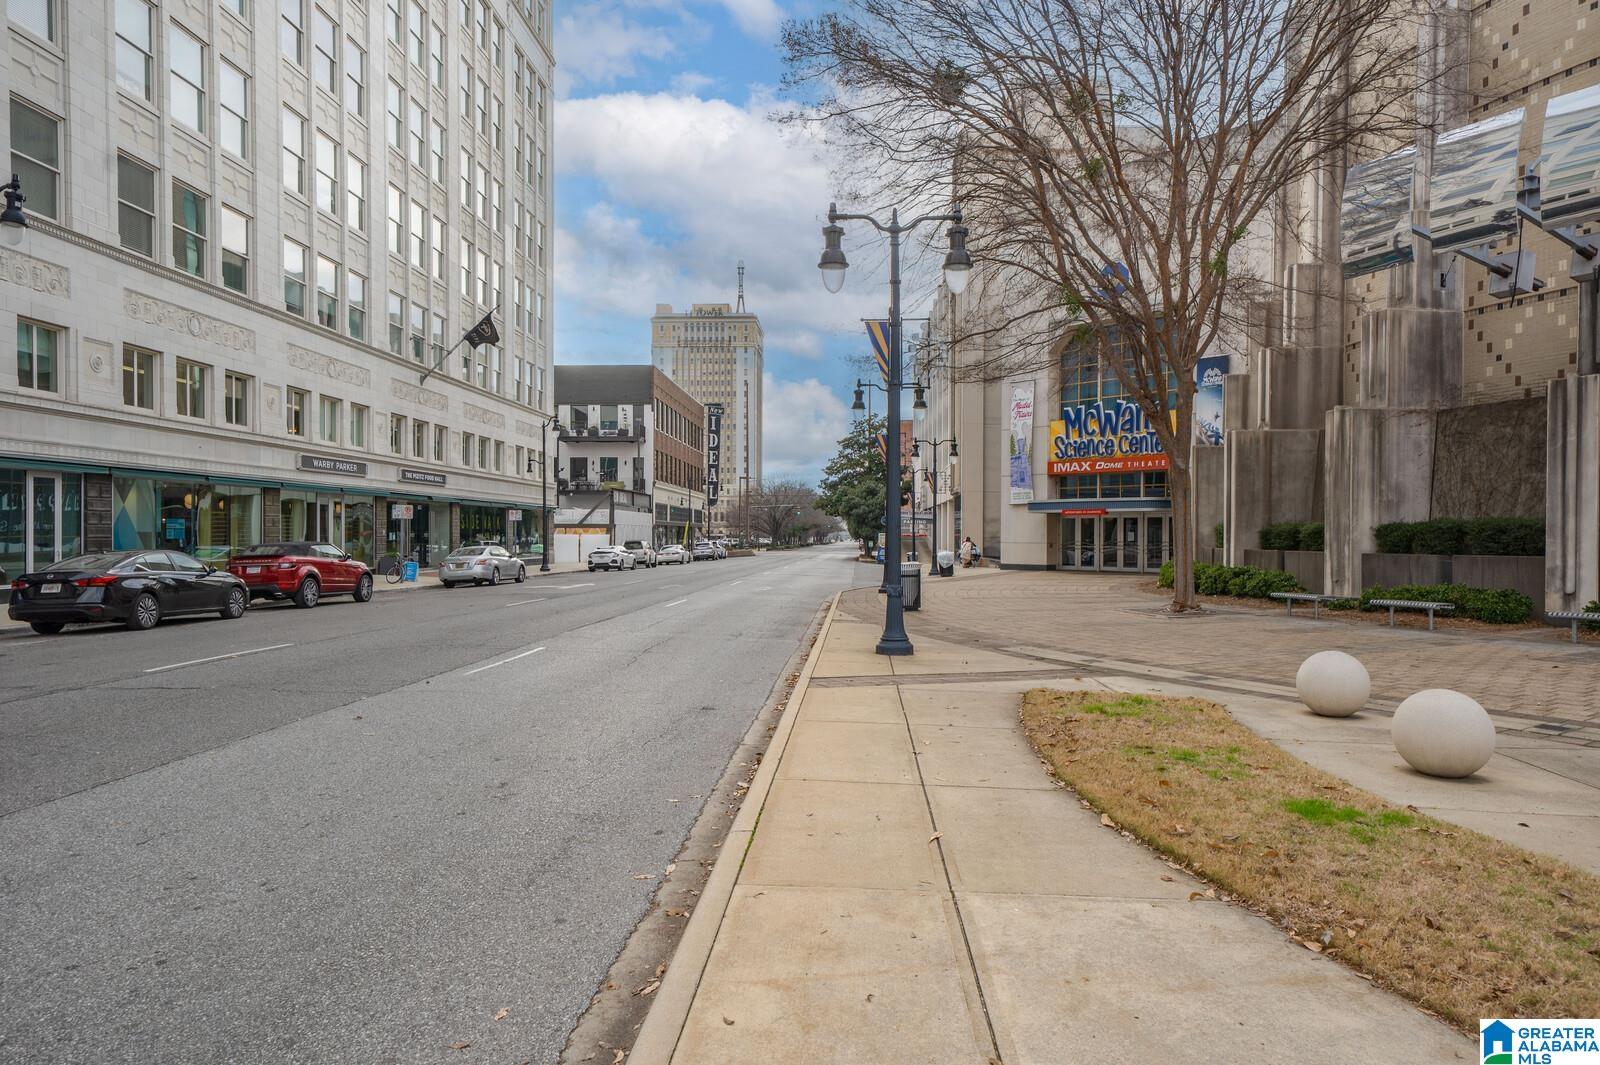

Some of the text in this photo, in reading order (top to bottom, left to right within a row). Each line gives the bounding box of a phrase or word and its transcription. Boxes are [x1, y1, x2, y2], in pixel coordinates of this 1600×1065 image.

[1054, 431, 1164, 459] Science Cente
[312, 458, 358, 472] WARBY PARKER
[708, 416, 719, 500] IDEAL
[1053, 461, 1091, 473] IMAX
[1128, 459, 1166, 468] THEATE
